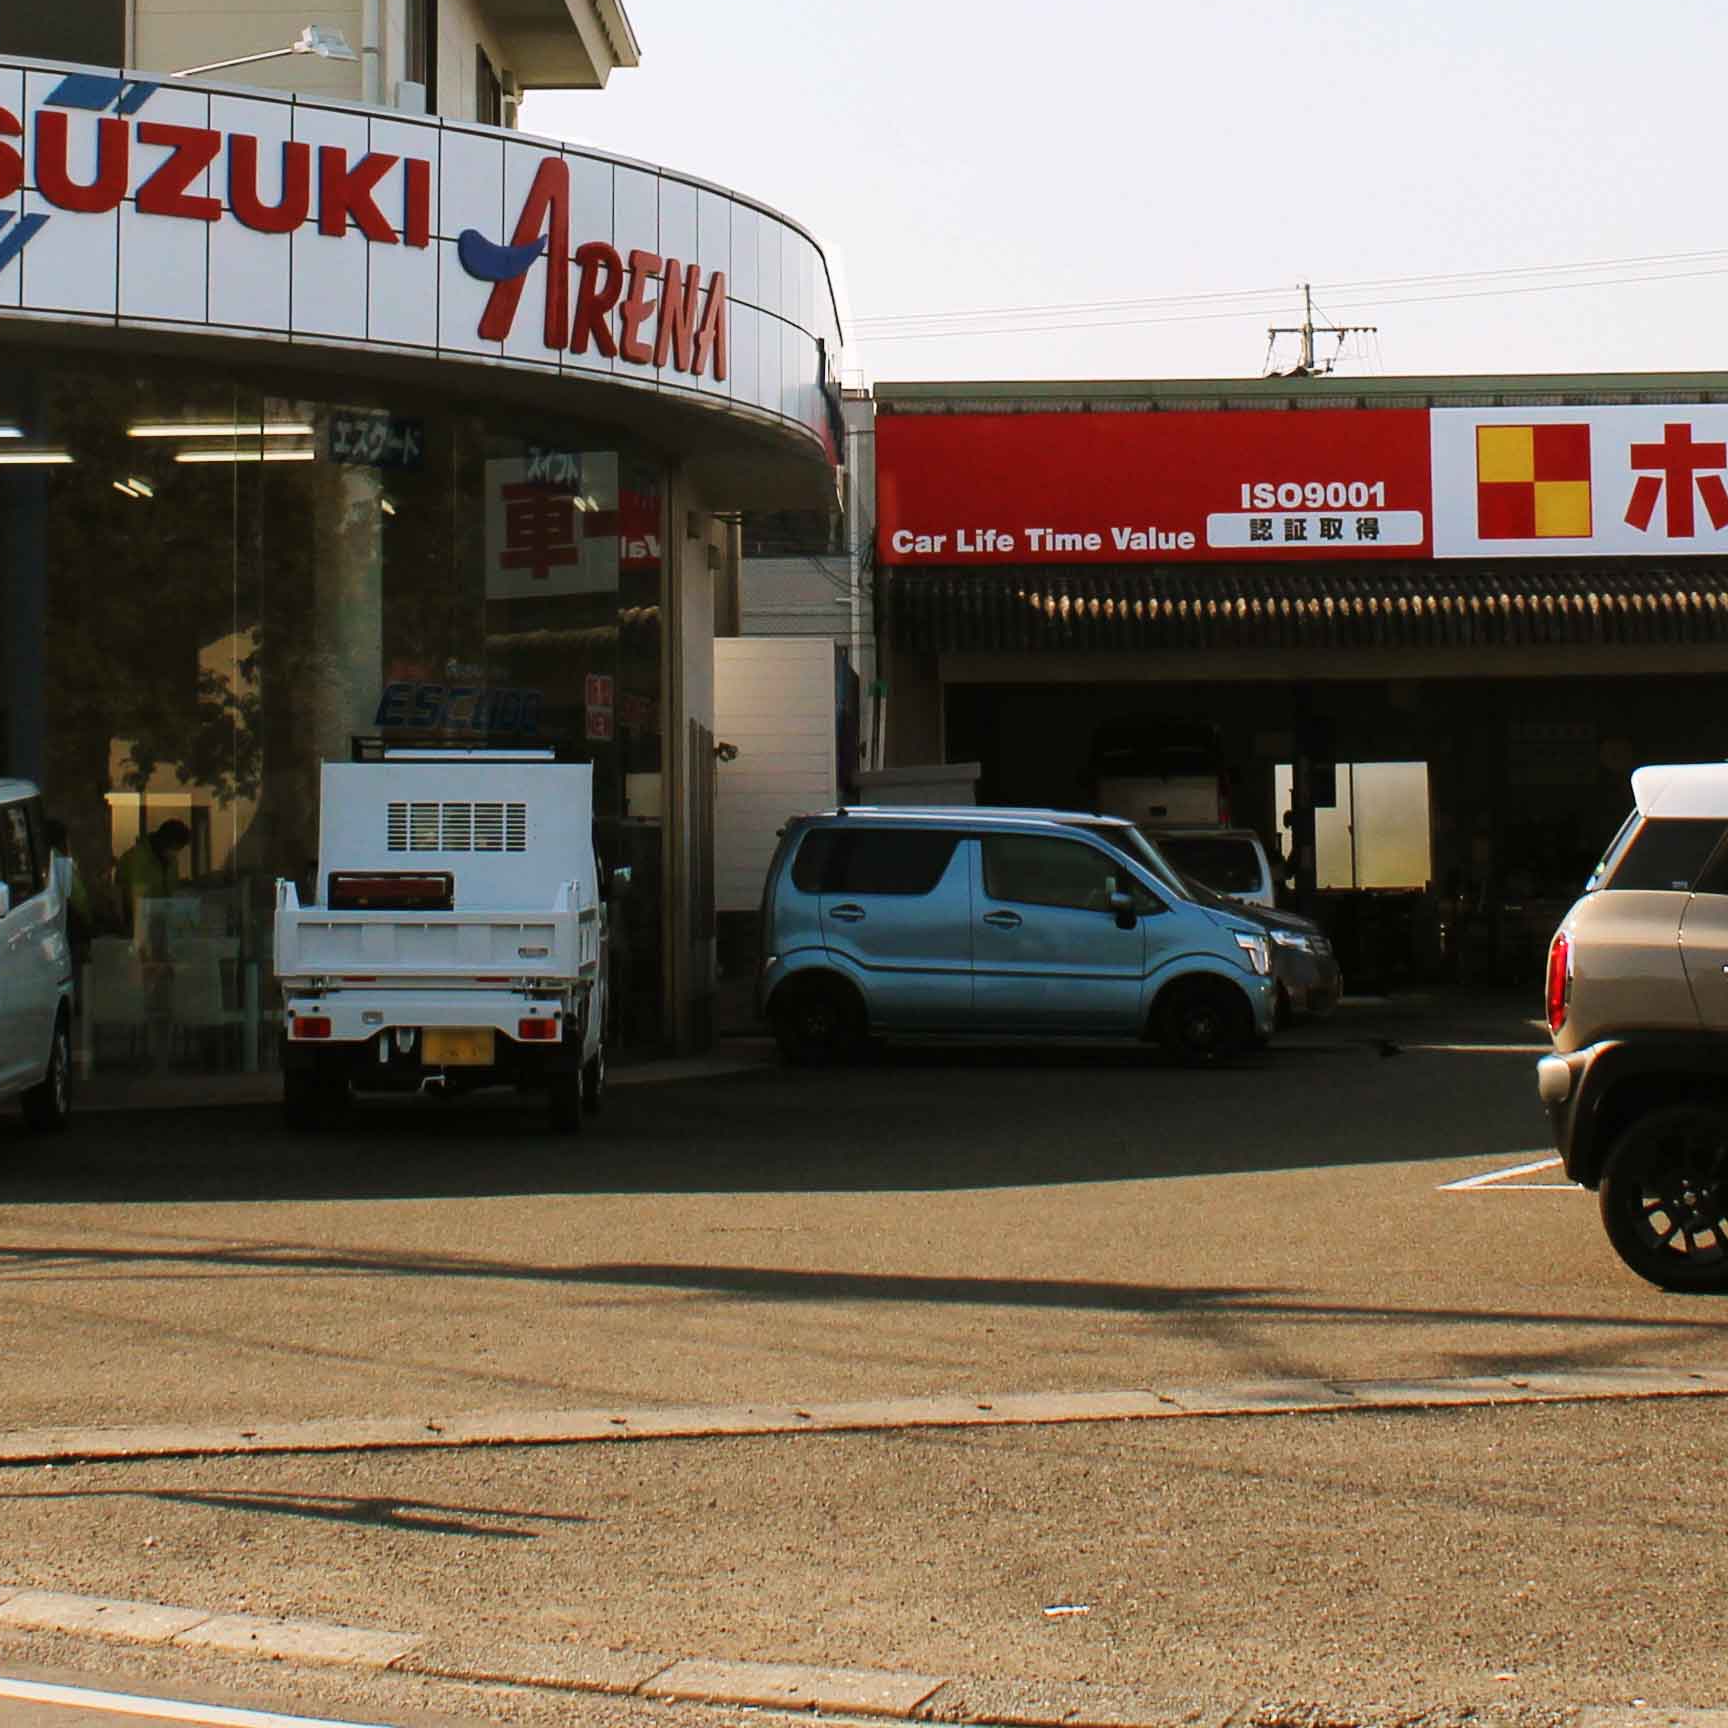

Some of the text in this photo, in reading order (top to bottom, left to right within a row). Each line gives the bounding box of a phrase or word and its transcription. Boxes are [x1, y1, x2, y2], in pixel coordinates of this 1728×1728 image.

[459, 156, 727, 382] ARENA
[1241, 481, 1386, 509] ISO9001
[892, 526, 1195, 553] Car Life Time Value
[1249, 516, 1380, 542] 認証取得
